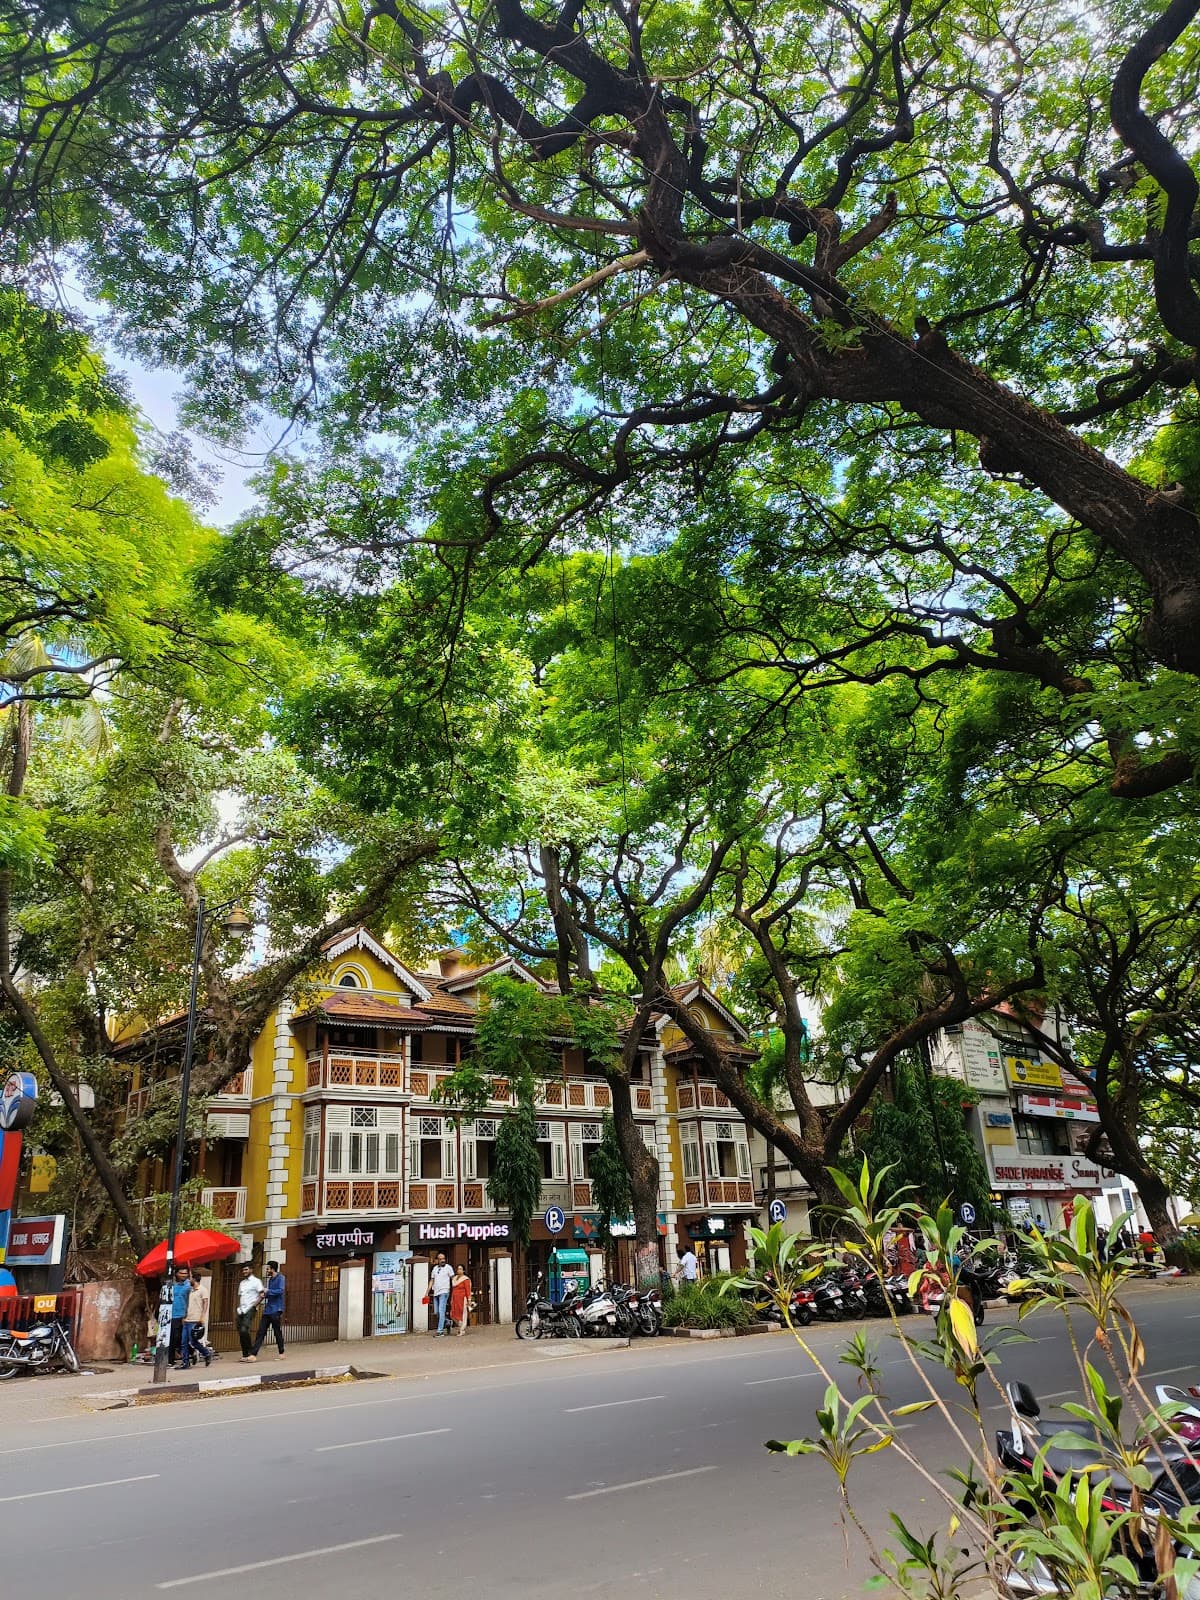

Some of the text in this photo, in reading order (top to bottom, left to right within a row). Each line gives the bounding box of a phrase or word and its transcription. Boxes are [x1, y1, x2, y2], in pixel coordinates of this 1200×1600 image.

[549, 1211, 558, 1228] P
[419, 1222, 509, 1240] Hush Puppies
[37, 1299, 56, 1309] OU
